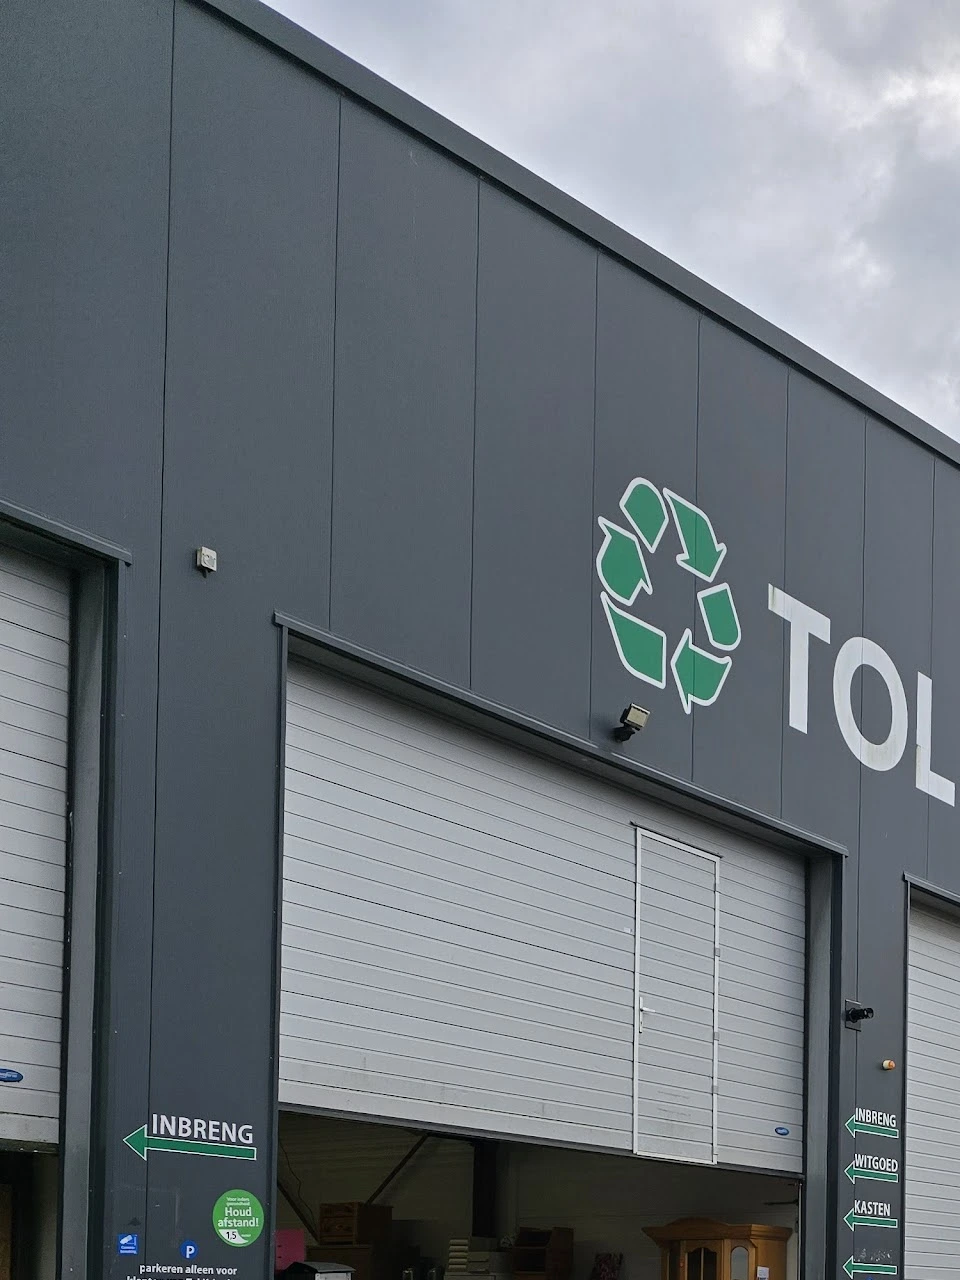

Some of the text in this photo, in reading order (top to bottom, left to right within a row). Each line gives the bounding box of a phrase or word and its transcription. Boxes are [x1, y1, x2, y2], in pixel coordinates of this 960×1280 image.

[767, 583, 956, 807] TOL
[855, 1107, 897, 1127] INBRENG
[152, 1114, 253, 1144] INBRENG
[854, 1153, 898, 1172] WITGOED
[225, 1206, 252, 1216] Houd
[854, 1200, 891, 1217] KASTEN
[217, 1217, 259, 1227] afstand!
[226, 1231, 237, 1240] 1,5
[139, 1264, 238, 1275] parkeren alleen voor
